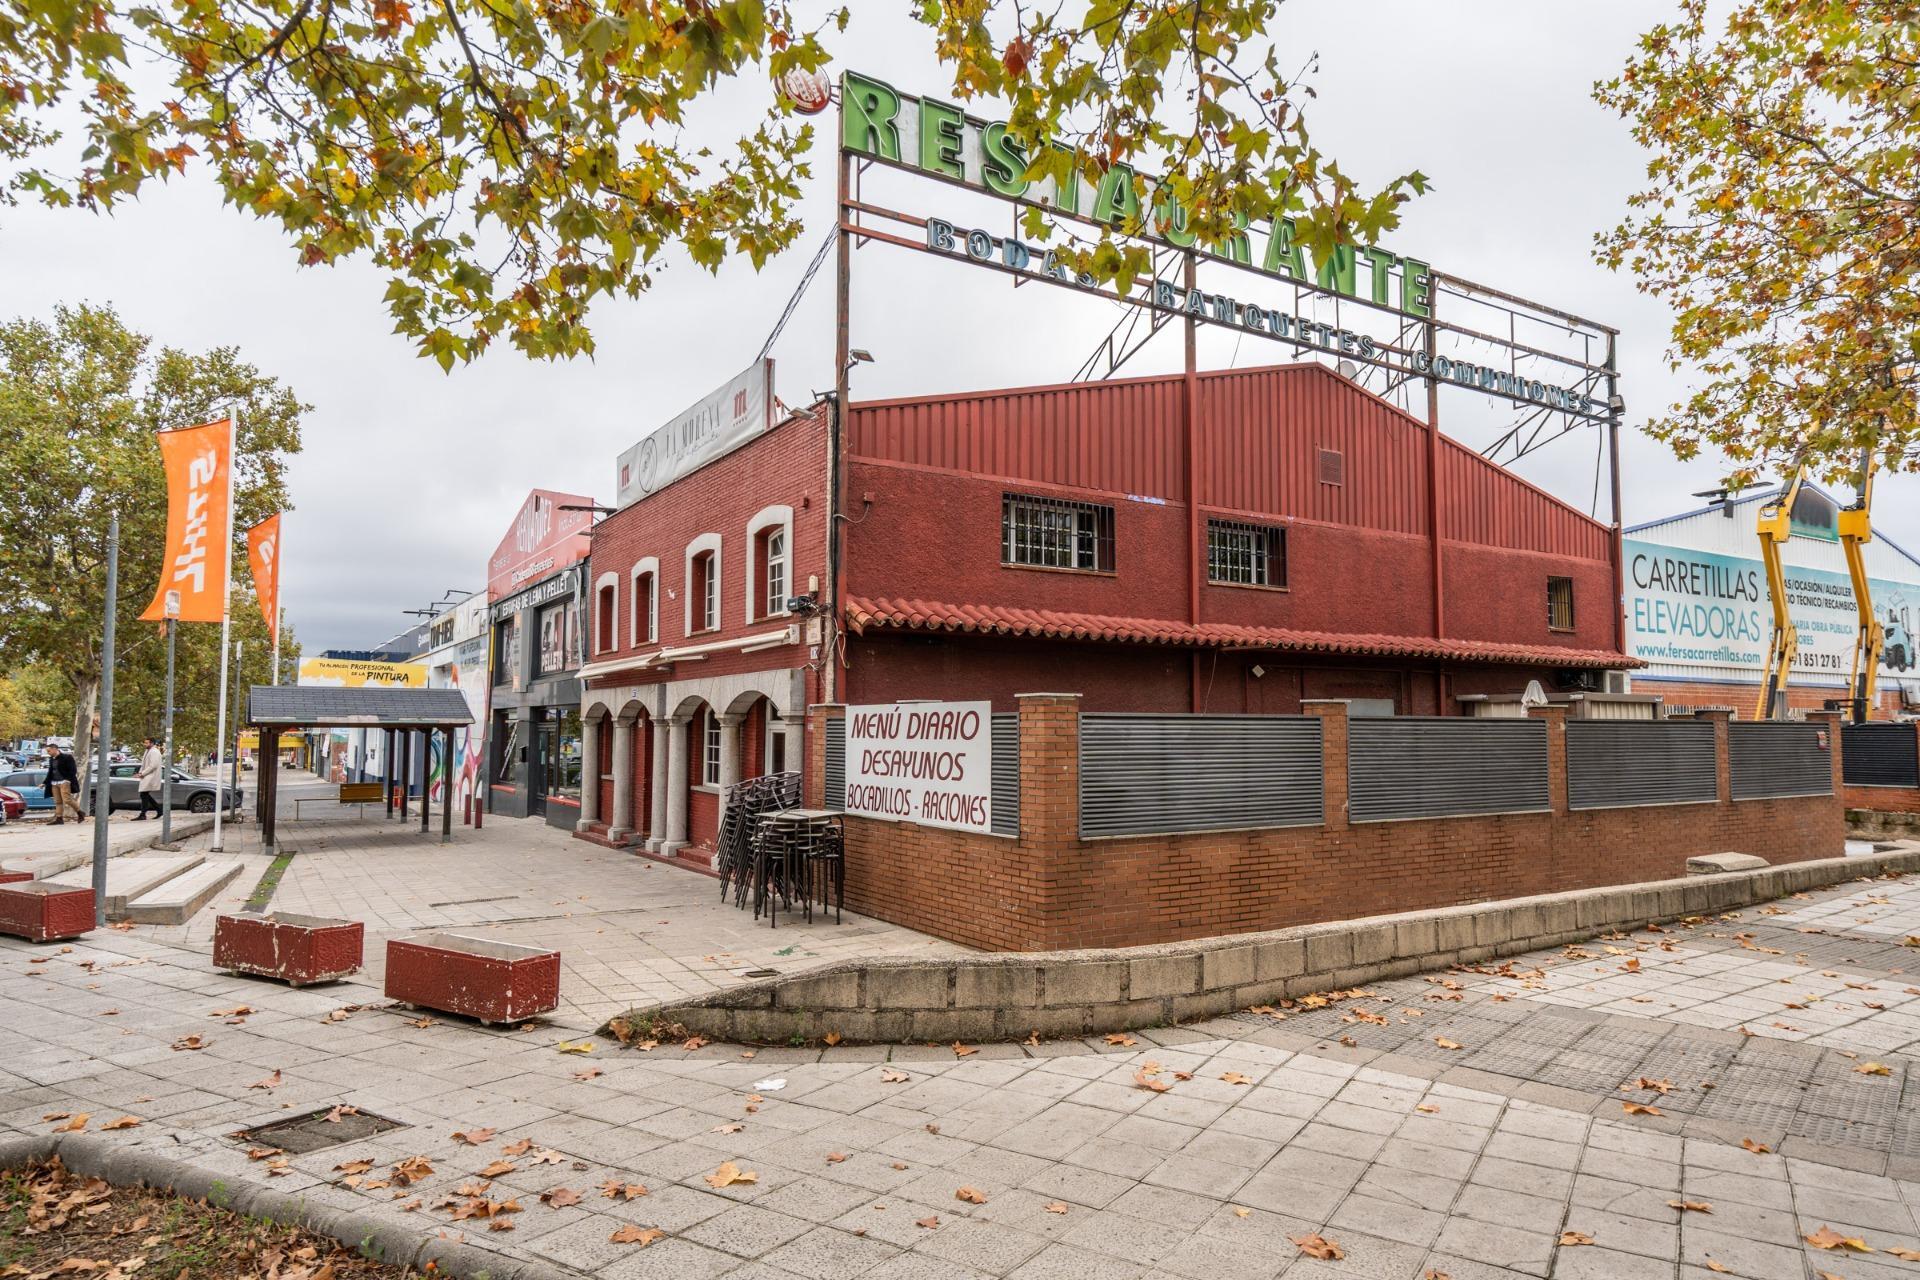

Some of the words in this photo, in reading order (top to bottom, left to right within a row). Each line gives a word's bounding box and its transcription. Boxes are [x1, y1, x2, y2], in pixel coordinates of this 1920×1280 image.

[1153, 279, 1375, 360] BANQUETES
[1411, 349, 1593, 416] COMUNIONES
[1632, 553, 1759, 603] CARRETILLAS
[1767, 576, 1852, 597] AS/OCASIÓN/ALQUILER
[502, 596, 521, 617] ESTUFAS
[521, 592, 529, 609] DE
[1634, 597, 1761, 643] ELEVADORAS
[1811, 620, 1829, 633] OBRA
[350, 663, 396, 672] PROFESIONAL
[1636, 642, 1761, 665] www.fersacarretillas.com
[1804, 652, 1819, 668] 851
[1820, 653, 1831, 669] 27
[1831, 655, 1841, 670] 81
[366, 671, 409, 683] PINTURA
[851, 706, 902, 739] MENÚ
[906, 710, 980, 741] DIARIO
[861, 749, 967, 782] DESAYUNOS
[847, 783, 912, 816] BOCADILLOS
[921, 790, 988, 826] RACIONES
